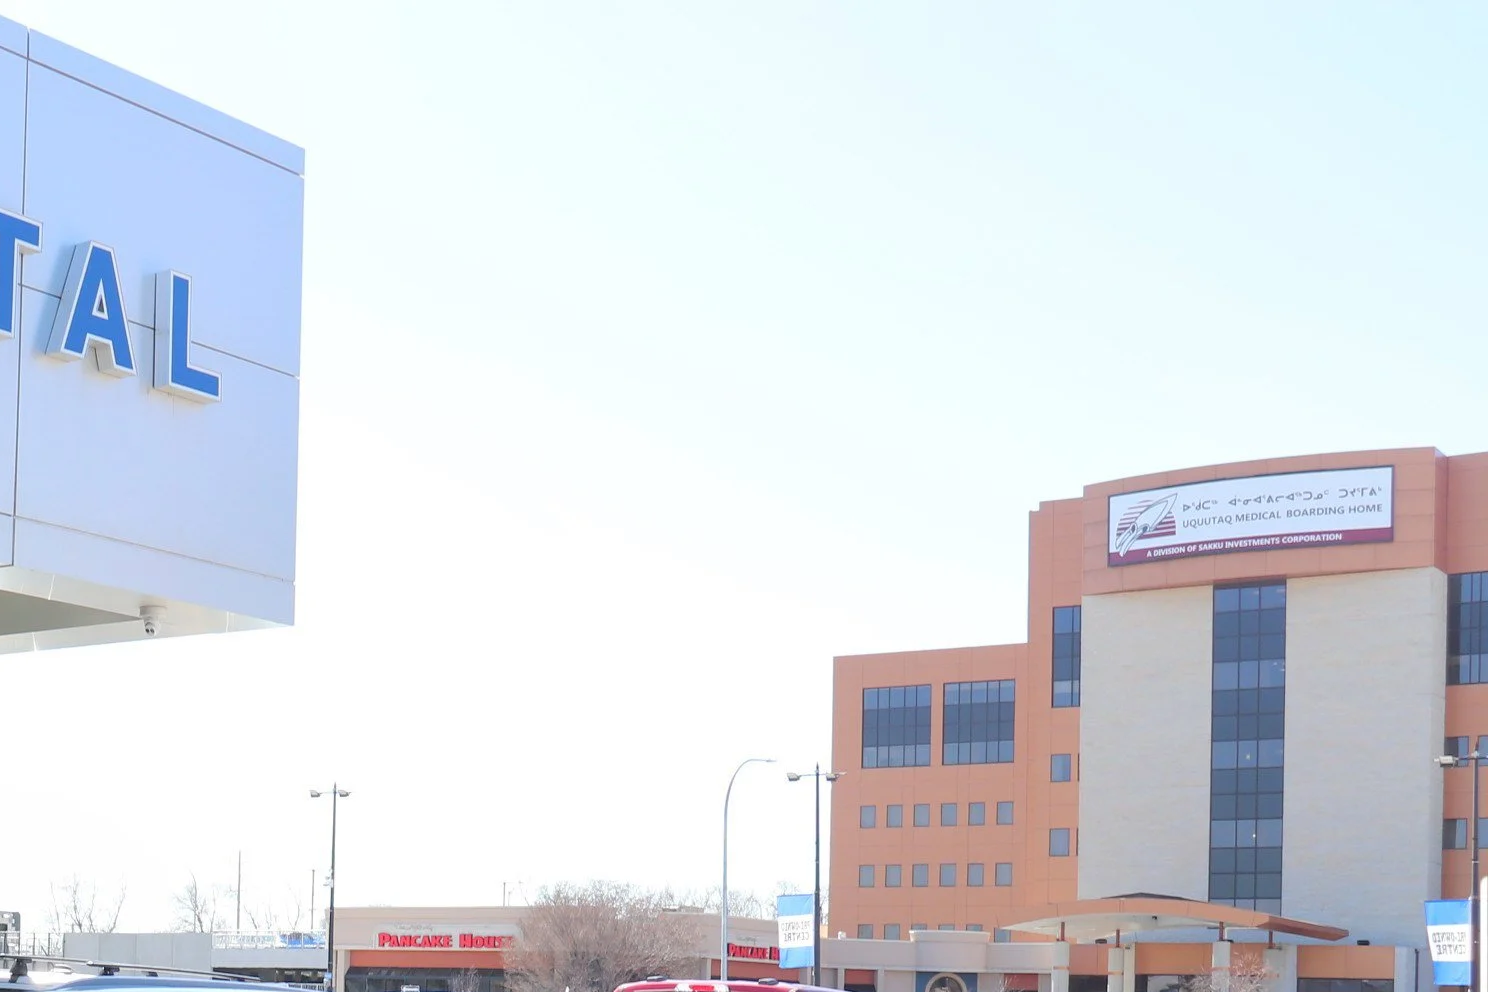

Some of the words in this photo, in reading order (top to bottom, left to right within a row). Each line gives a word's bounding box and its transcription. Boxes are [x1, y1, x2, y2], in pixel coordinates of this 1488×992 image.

[1182, 514, 1232, 529] UQUUTAQ
[1235, 510, 1281, 524] MEDICAL
[1286, 505, 1345, 519] BOARDING
[1348, 503, 1383, 514] HOME
[1146, 550, 1153, 558] A
[1153, 546, 1185, 557] DIVISION
[1185, 544, 1197, 553] OF
[1198, 541, 1223, 552] SAKKU
[1224, 536, 1280, 549] INVESTMENTS
[1281, 533, 1342, 544] CORPORATION
[378, 932, 453, 948] PANCAKE
